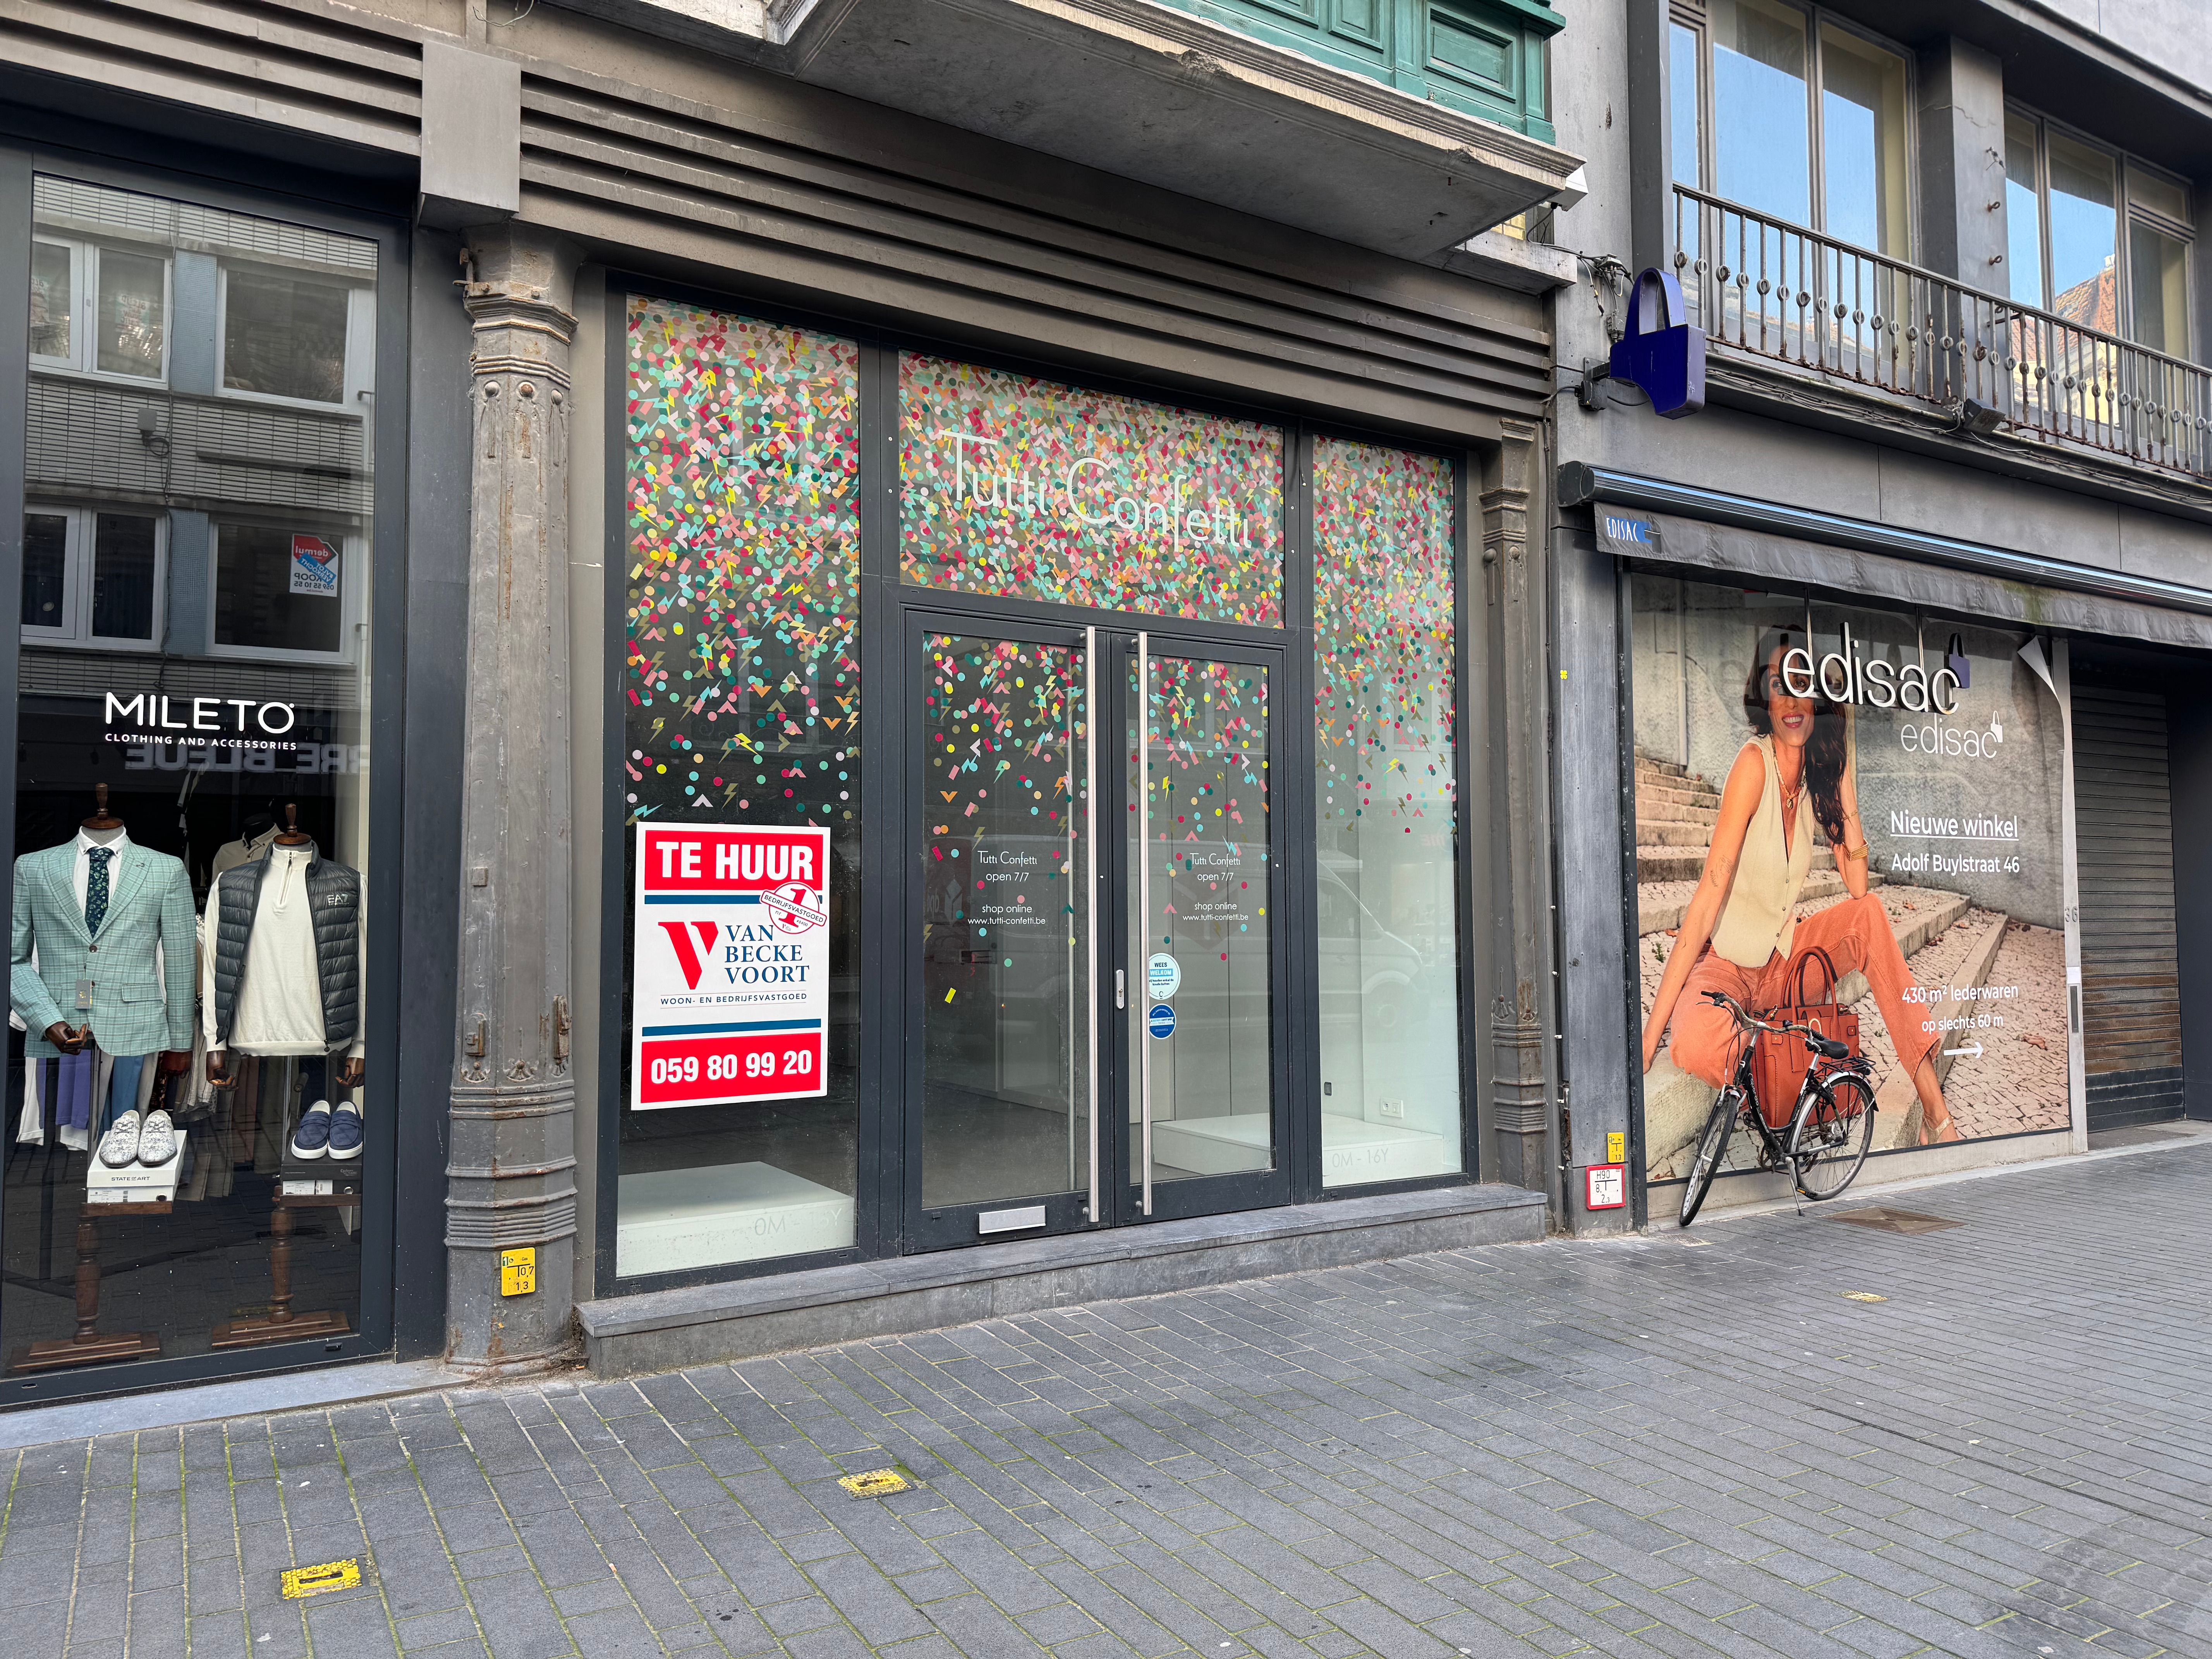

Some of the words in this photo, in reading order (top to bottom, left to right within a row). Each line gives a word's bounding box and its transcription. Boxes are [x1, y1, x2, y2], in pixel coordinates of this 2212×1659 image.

[939, 429, 1048, 516] Tutti
[1066, 457, 1251, 552] Confetti
[1606, 517, 1638, 542] EDISAC
[1781, 622, 1960, 714] edisac
[105, 692, 294, 734] MILETO
[105, 733, 172, 744] CLOTHING
[179, 737, 206, 746] AND
[211, 738, 297, 750] ACCESSORIES
[1900, 713, 1997, 759] edisac
[1891, 809, 1959, 836] Nieuwe
[1963, 812, 2018, 838] winkel
[656, 841, 701, 878] TE
[716, 843, 813, 881] HUUR
[977, 850, 998, 864] Tutti
[1000, 851, 1037, 867] Confetti
[1190, 853, 1207, 865] Tutti
[1209, 853, 1240, 867] Confetti
[1891, 852, 1929, 871] Adolf
[1933, 854, 2001, 876] Buylstraat
[2004, 856, 2020, 873] 46
[986, 873, 1011, 883] open
[1014, 872, 1029, 882] 7/7
[1197, 874, 1219, 882] open
[1221, 872, 1234, 881] 7/7
[327, 894, 348, 903] EA7
[1194, 902, 1213, 912] shop
[1215, 902, 1237, 910] online
[764, 895, 823, 923] BEDRIJFSVASTGOED
[982, 904, 1004, 915] shop
[1006, 904, 1032, 913] online
[2065, 906, 2078, 922] 36
[727, 924, 773, 942] VAN
[725, 945, 803, 963] BECKE
[724, 965, 809, 984] VOORT
[660, 996, 695, 1005] WOON-
[716, 993, 807, 1003] BEDRIJFSVASTGOED
[1902, 986, 1926, 1003] 430
[1951, 984, 2018, 1001] lederwaren
[1922, 1020, 1936, 1035] op
[1938, 1015, 1975, 1031] slechts
[1978, 1014, 1990, 1028] 60
[1994, 1015, 2003, 1027] m
[651, 1056, 699, 1084] 059
[707, 1054, 738, 1080] 80
[746, 1051, 774, 1078] 99
[783, 1049, 812, 1075] 20
[1597, 1170, 1610, 1179] H90
